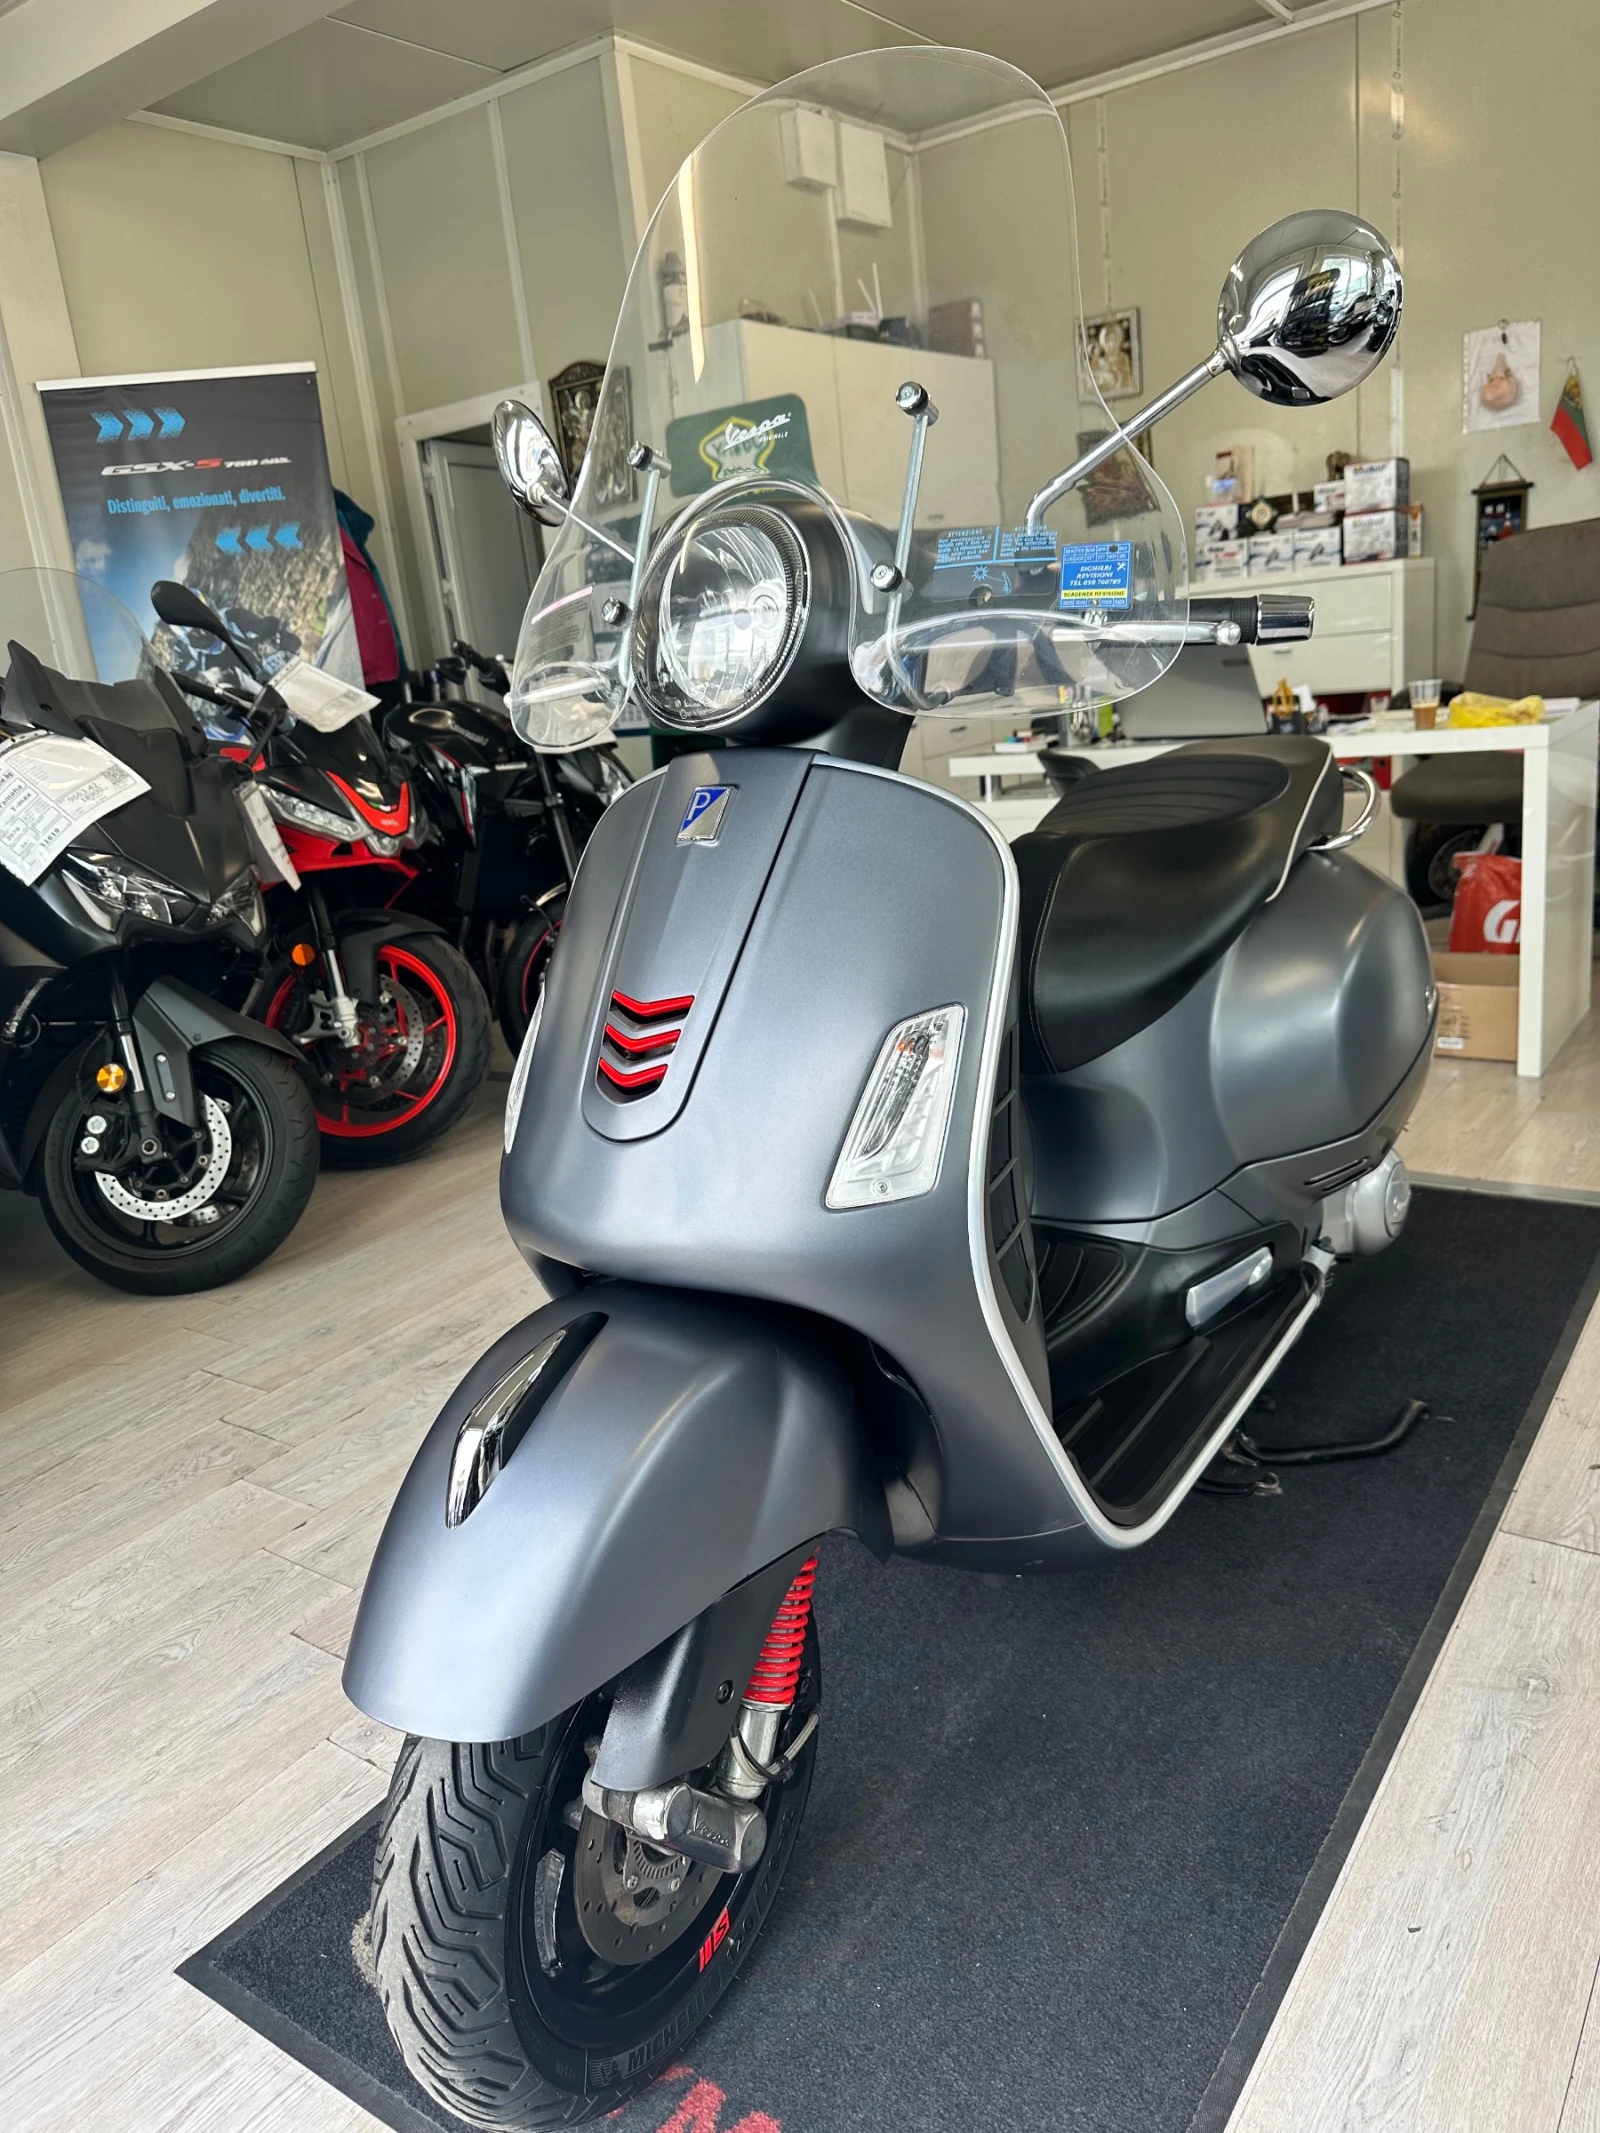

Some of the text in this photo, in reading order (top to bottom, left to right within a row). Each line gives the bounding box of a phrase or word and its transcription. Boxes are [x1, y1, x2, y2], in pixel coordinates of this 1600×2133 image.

[101, 458, 223, 476] GSX-S
[107, 486, 286, 515] Distinguiti, emozionati, divertiti.
